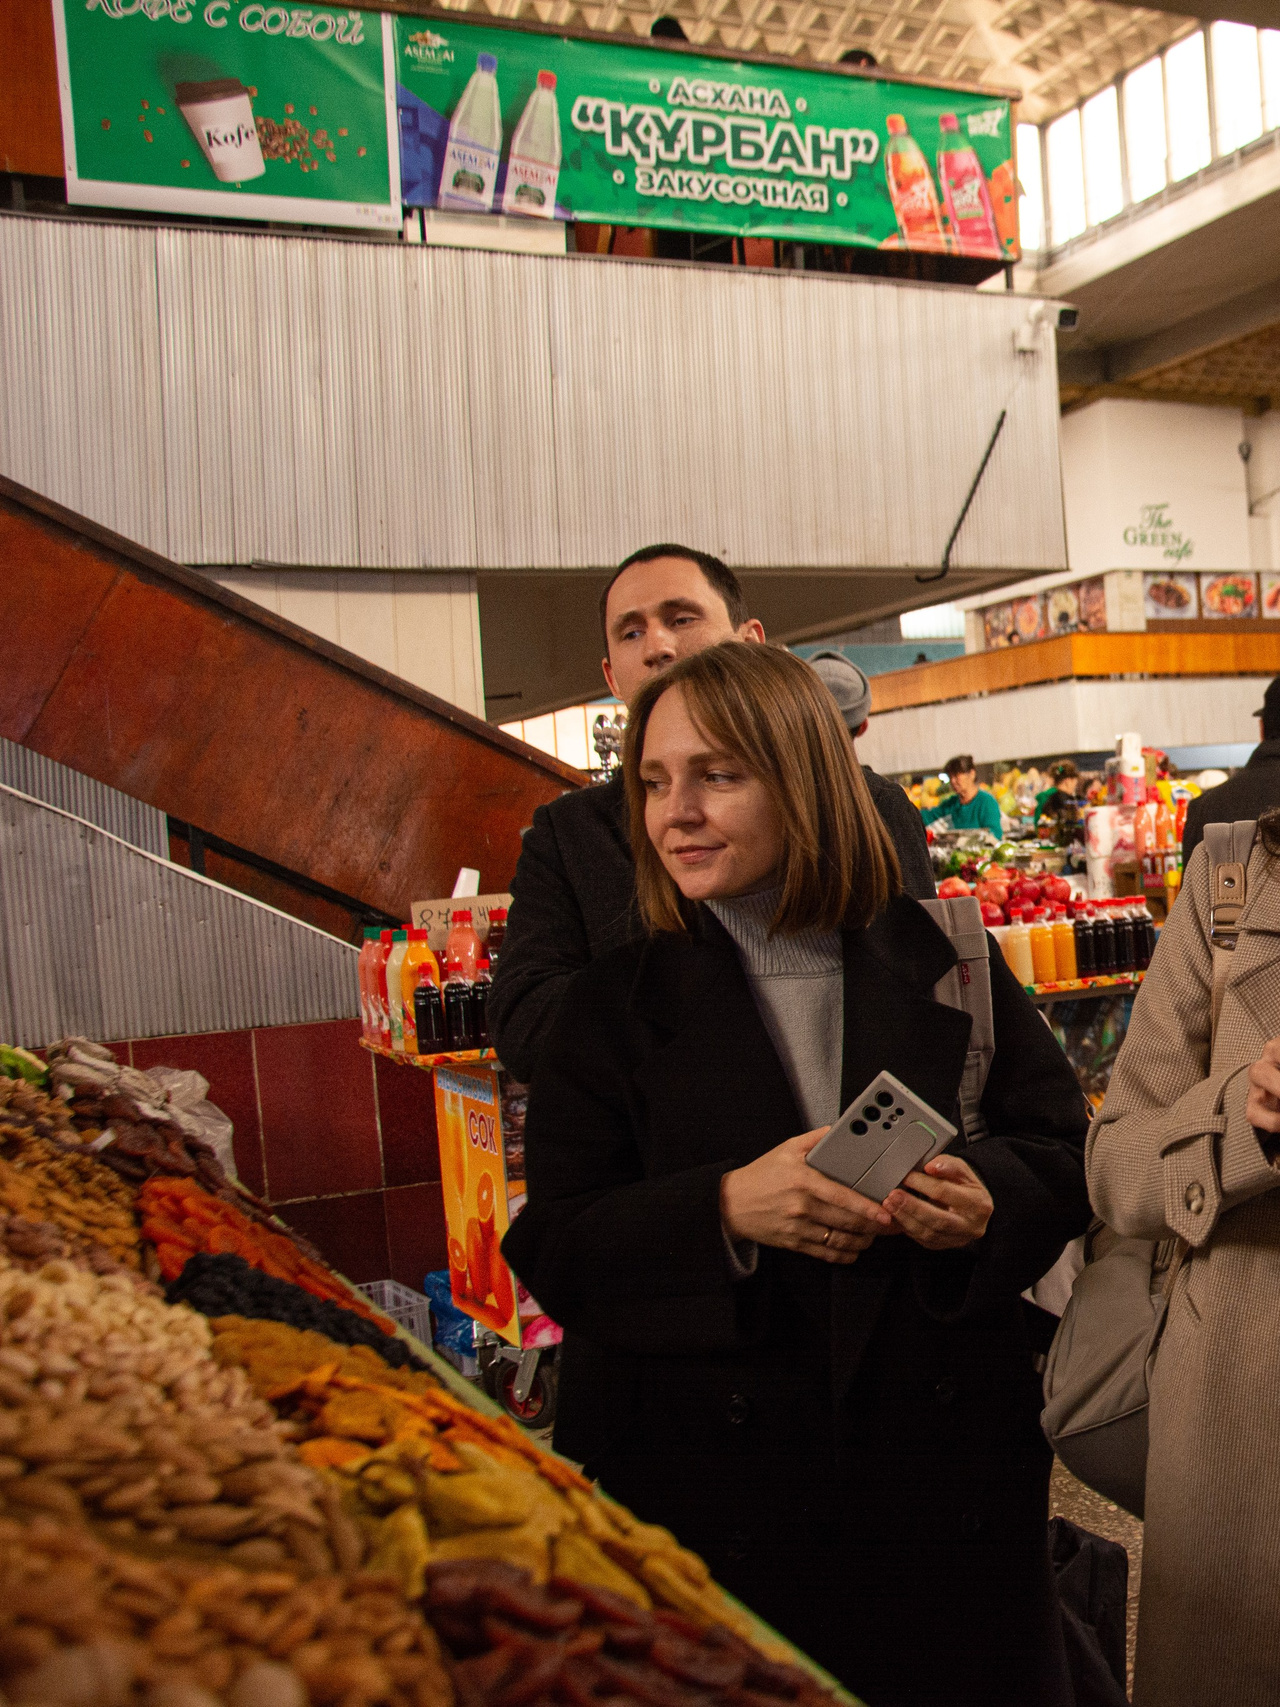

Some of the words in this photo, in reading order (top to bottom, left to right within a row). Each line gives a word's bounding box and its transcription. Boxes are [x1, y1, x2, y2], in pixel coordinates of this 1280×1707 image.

[204, 0, 231, 28] С
[239, 3, 364, 45] СОБОЙ
[668, 78, 790, 118] АСХАНА
[205, 123, 254, 148] Kofe
[635, 166, 828, 212] ЗАКУСОЧНАЯ
[1139, 502, 1172, 530] The
[468, 1109, 498, 1155] СОК
